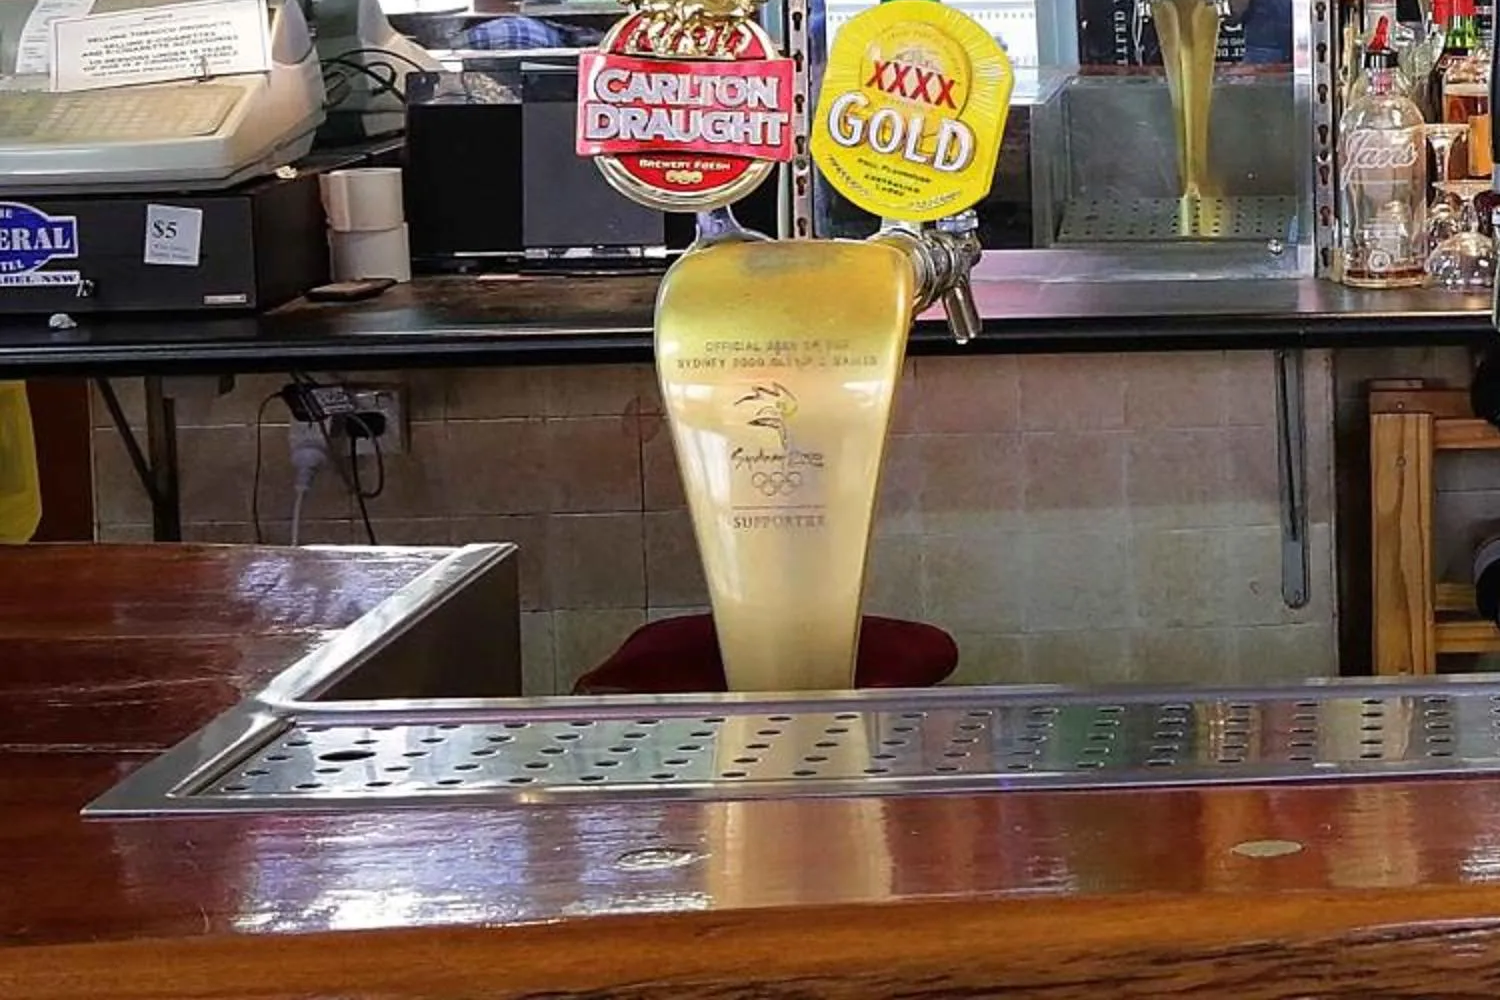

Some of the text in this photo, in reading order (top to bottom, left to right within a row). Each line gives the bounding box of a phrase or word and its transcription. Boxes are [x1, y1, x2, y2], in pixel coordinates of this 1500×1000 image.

[594, 69, 779, 110] CARLTON
[865, 59, 958, 112] XXXX
[584, 102, 789, 146] DRAUGHT
[828, 91, 977, 173] GOLD
[152, 219, 178, 239] $5
